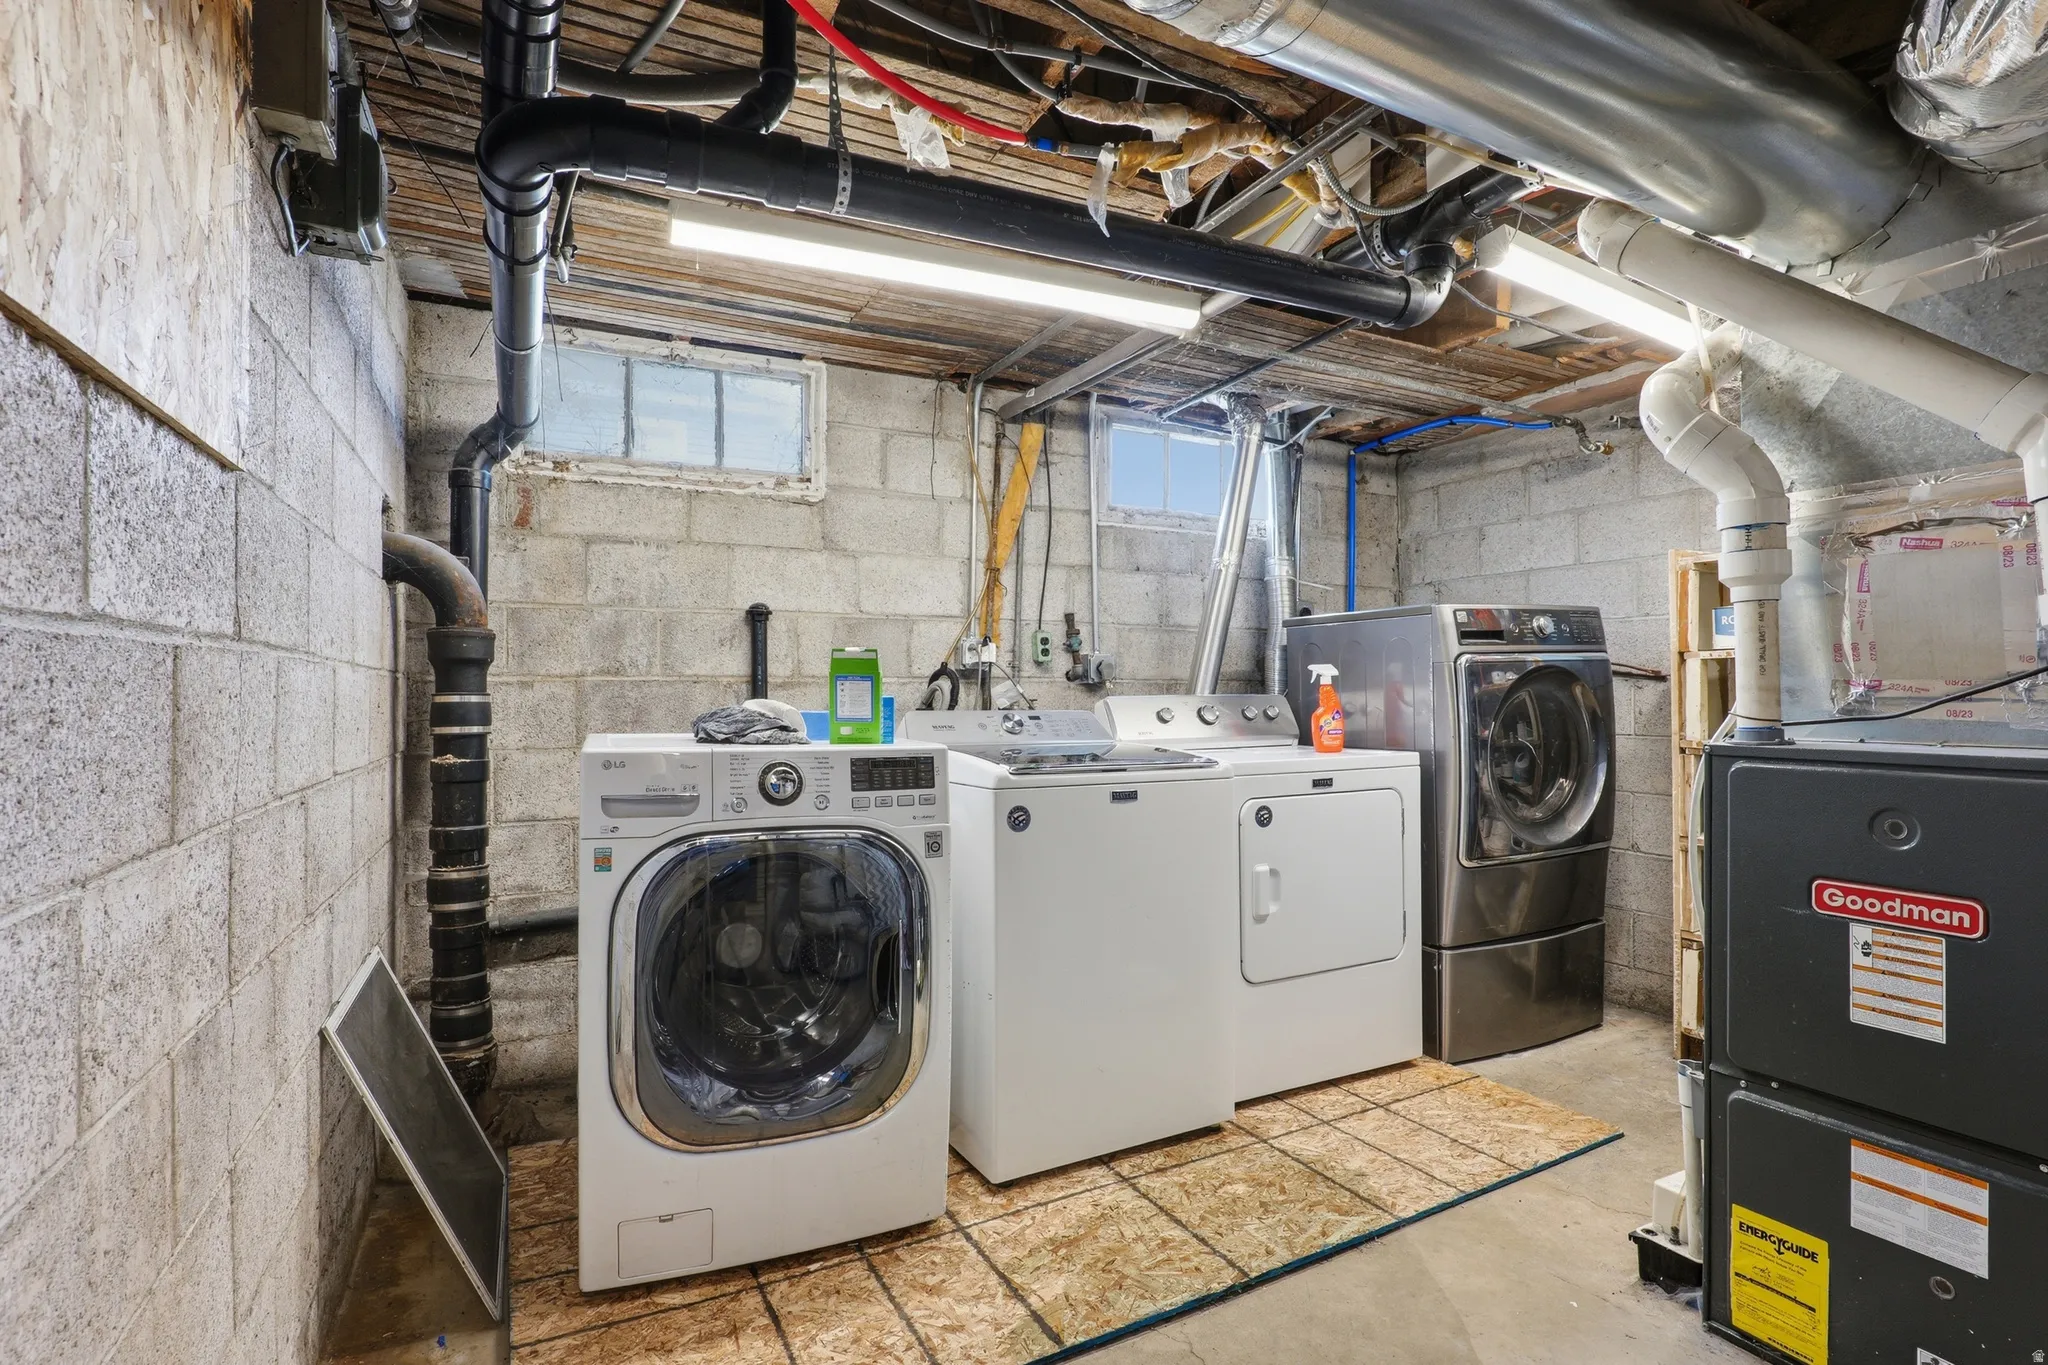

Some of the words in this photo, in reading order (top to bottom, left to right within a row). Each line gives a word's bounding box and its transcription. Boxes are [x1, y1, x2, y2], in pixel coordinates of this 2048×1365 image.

[1902, 538, 1940, 548] Nashua
[2003, 545, 2014, 568] 08/23
[2026, 543, 2037, 566] 08/23
[1858, 599, 1867, 620] 324A
[1834, 643, 1843, 663] 08/23
[1851, 642, 1861, 662] 08/23
[1888, 683, 1913, 693] 324A
[1946, 709, 1973, 718] 08/23
[614, 761, 626, 769] LG
[1823, 888, 1970, 928] Goodman
[1739, 1221, 1819, 1264] ENERGYGUIDE
